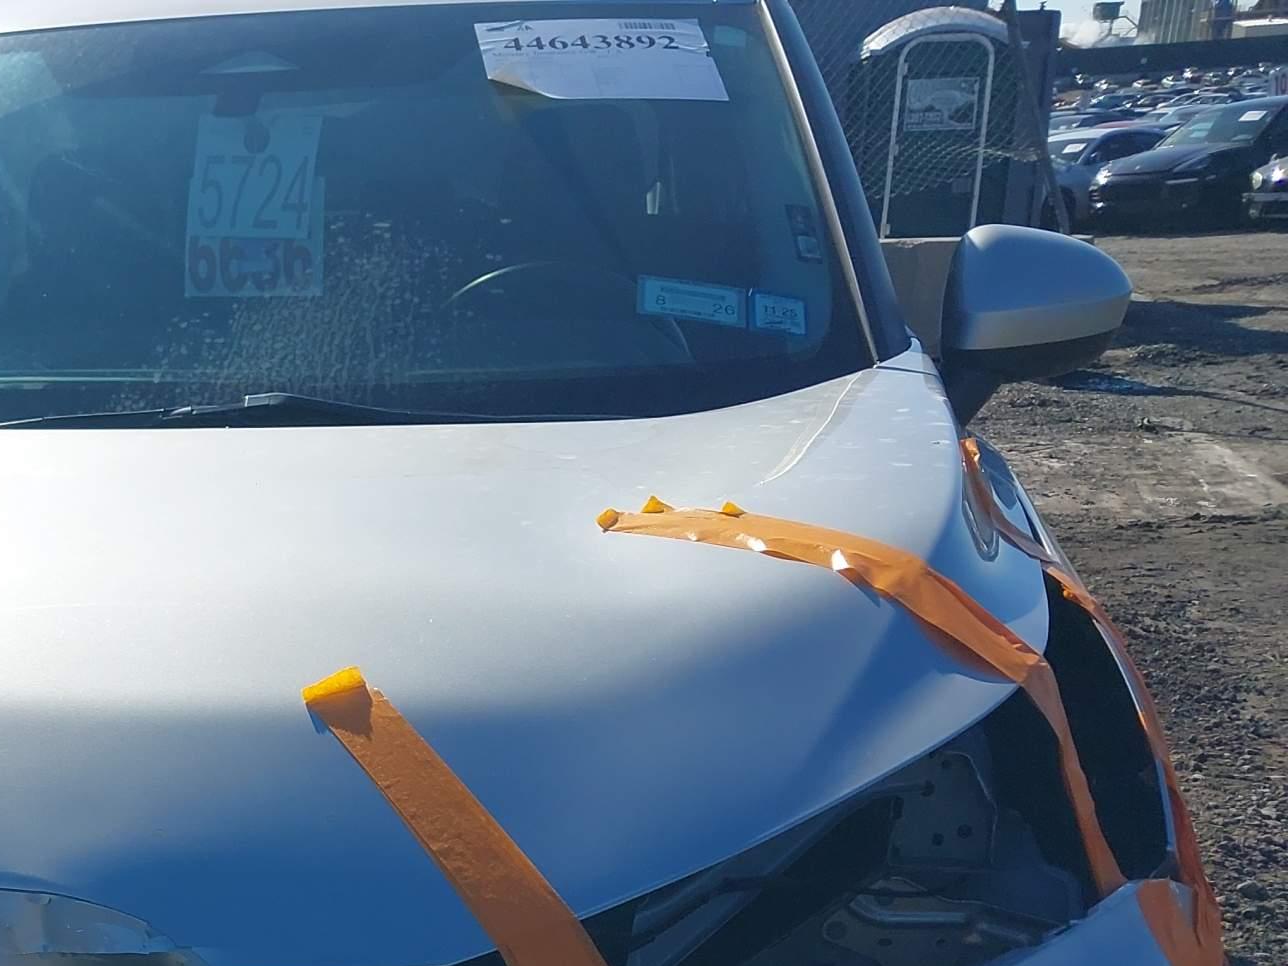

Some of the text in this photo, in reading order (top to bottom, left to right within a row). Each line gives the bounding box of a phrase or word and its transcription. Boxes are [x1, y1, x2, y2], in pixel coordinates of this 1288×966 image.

[503, 33, 680, 51] 44643892
[198, 153, 309, 231] 5724
[712, 303, 736, 316] 26
